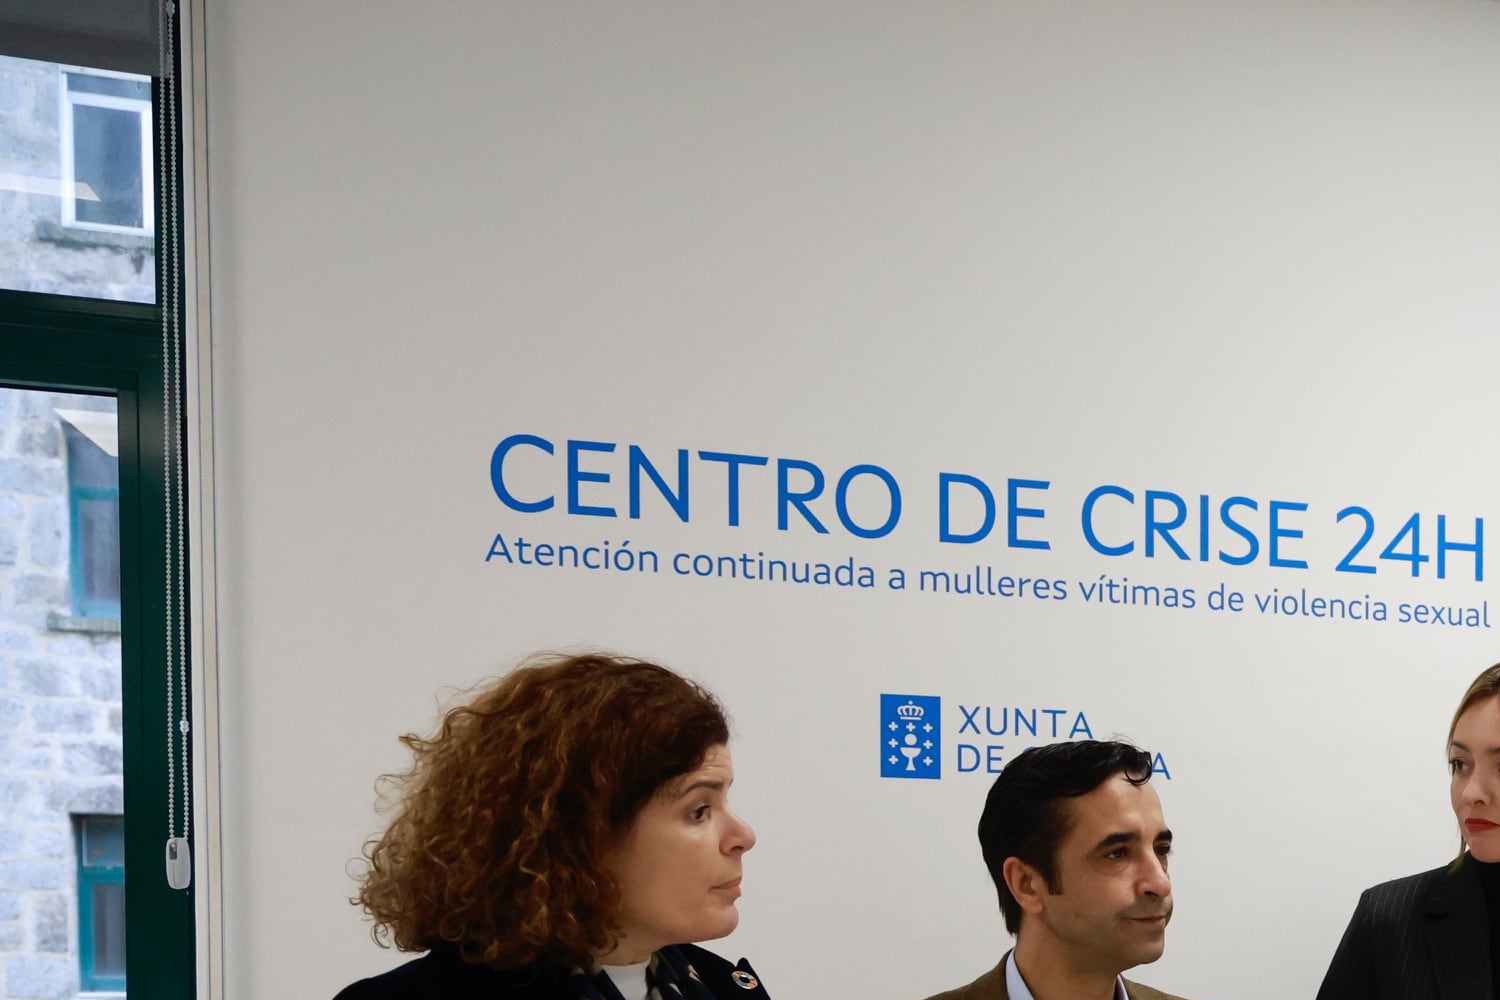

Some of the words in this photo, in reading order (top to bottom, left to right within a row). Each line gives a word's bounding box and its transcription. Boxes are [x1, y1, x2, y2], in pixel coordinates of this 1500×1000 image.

[489, 433, 902, 540] CENTRO
[938, 471, 1052, 551] DE
[1080, 484, 1310, 571] CRISE
[1334, 504, 1485, 583] 24H
[485, 533, 659, 573] Atención
[672, 551, 875, 589] continuada
[888, 568, 906, 591] a
[919, 568, 1068, 601] mulleres
[1079, 574, 1197, 610] vítimas
[1207, 584, 1245, 613] de
[1254, 588, 1388, 622] violencia
[1398, 601, 1492, 629] sexual
[957, 705, 1094, 739] XUNTA
[956, 743, 1004, 774] DE
